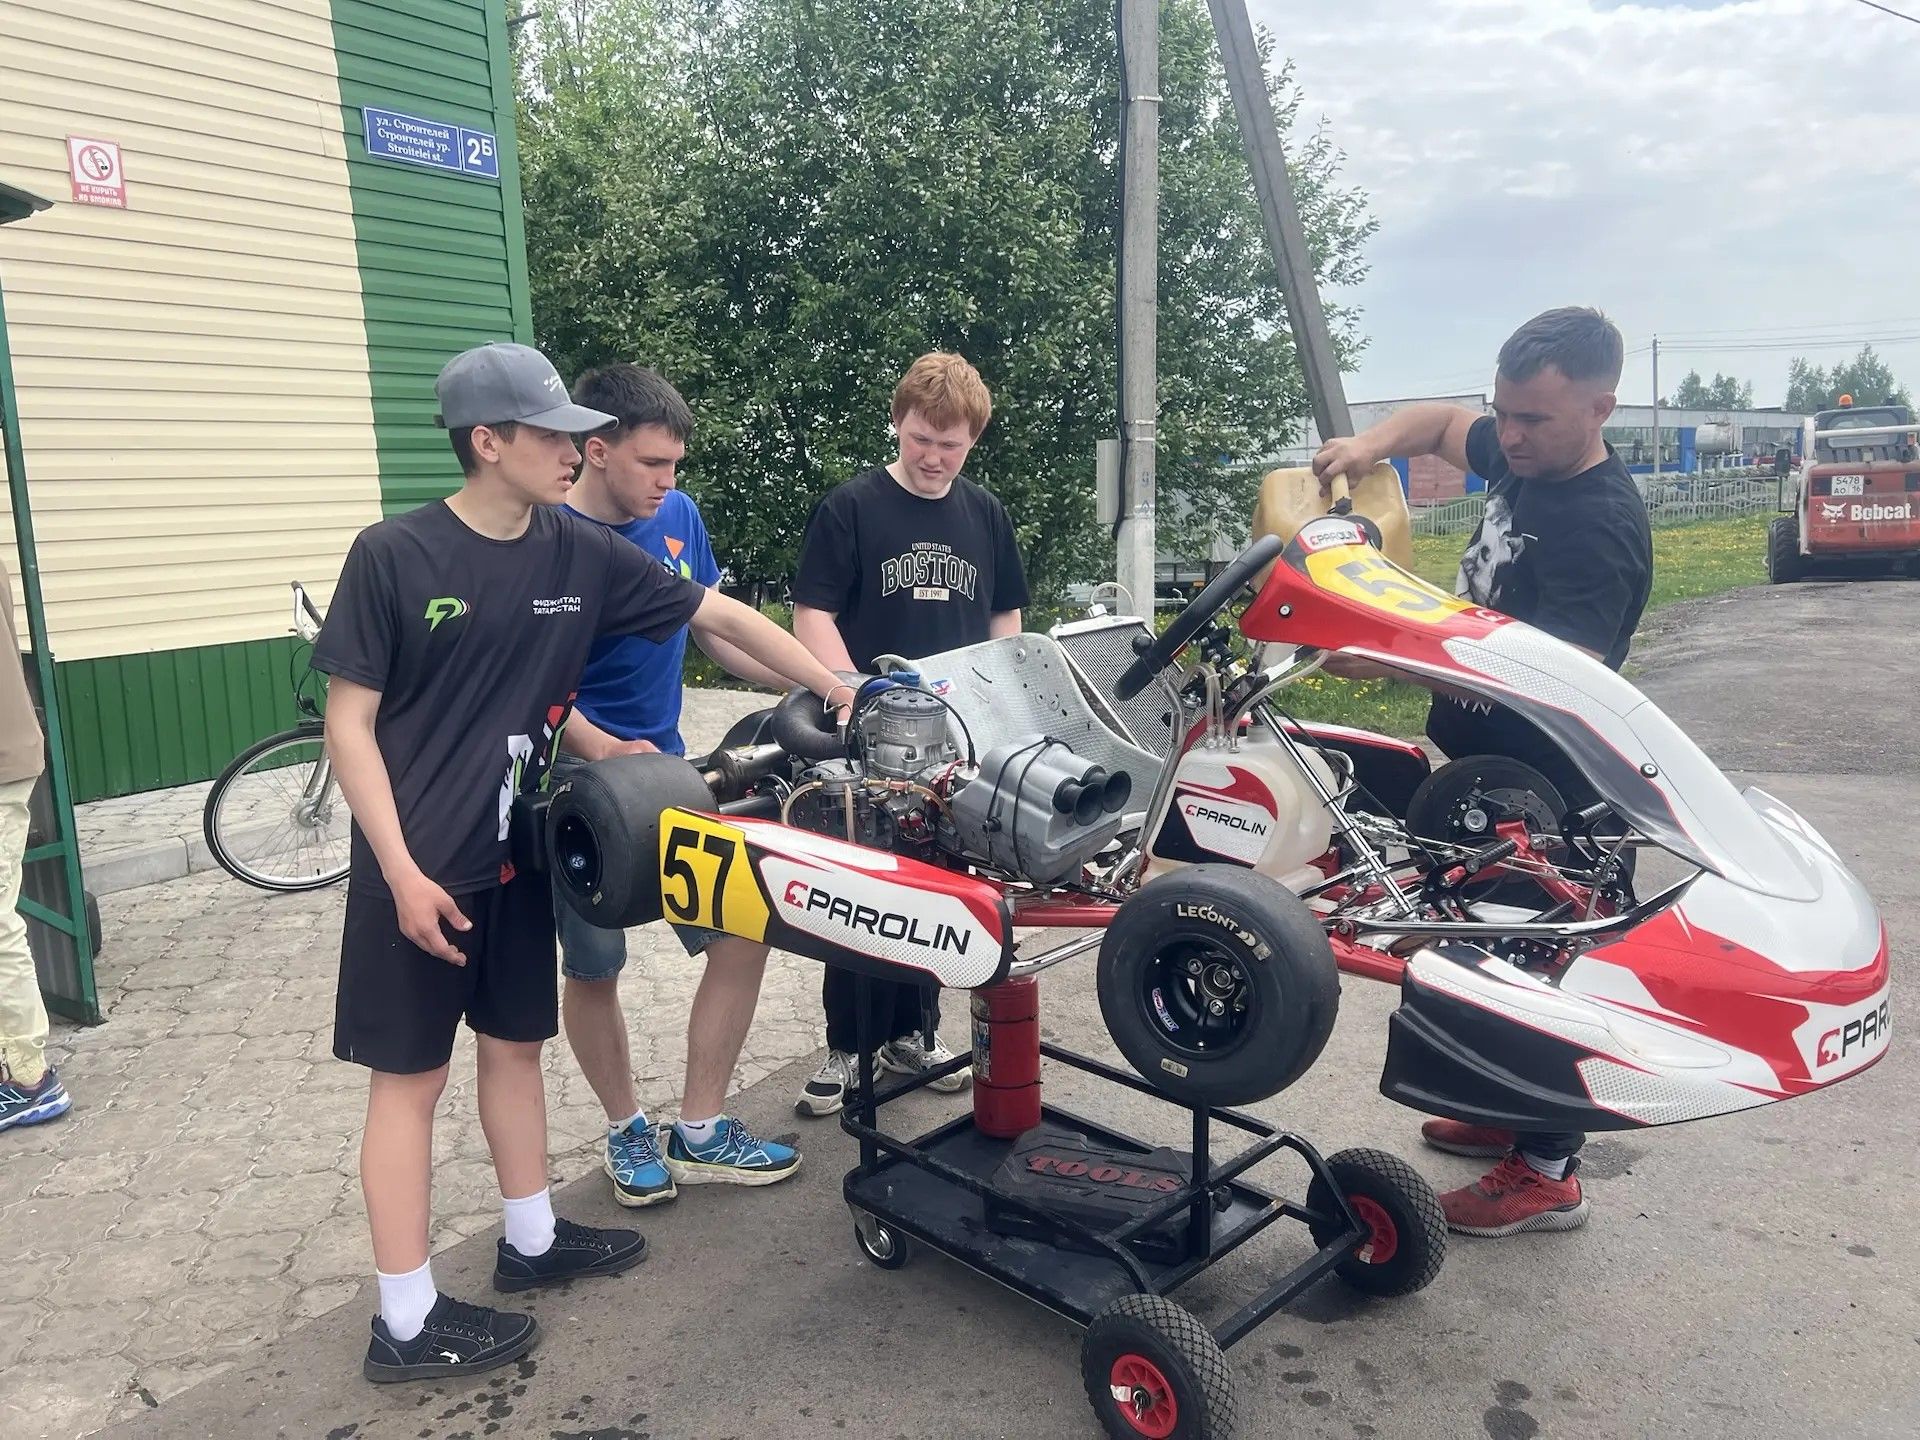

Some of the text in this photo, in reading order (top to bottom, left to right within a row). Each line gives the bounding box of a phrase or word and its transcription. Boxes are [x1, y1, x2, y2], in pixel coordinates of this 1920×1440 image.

[375, 116, 450, 140] ул. Строителей
[377, 128, 451, 154] Строителей ур.
[387, 142, 444, 163] Stroitelei st.
[1836, 476, 1860, 486] 5478
[1850, 502, 1912, 521] Bobcat
[911, 542, 952, 553] UNITED STATES
[881, 550, 977, 601] BOSTON
[1334, 558, 1441, 612] 5
[532, 596, 581, 607] ФИДЖИТАЛ
[532, 604, 581, 615] ТАТАРСТАН
[1195, 807, 1267, 836] PAROLIN
[663, 826, 737, 929] 57
[806, 887, 972, 956] PAROLIN
[1842, 993, 1891, 1058] PAR
[1026, 1155, 1183, 1193] TOOLS
